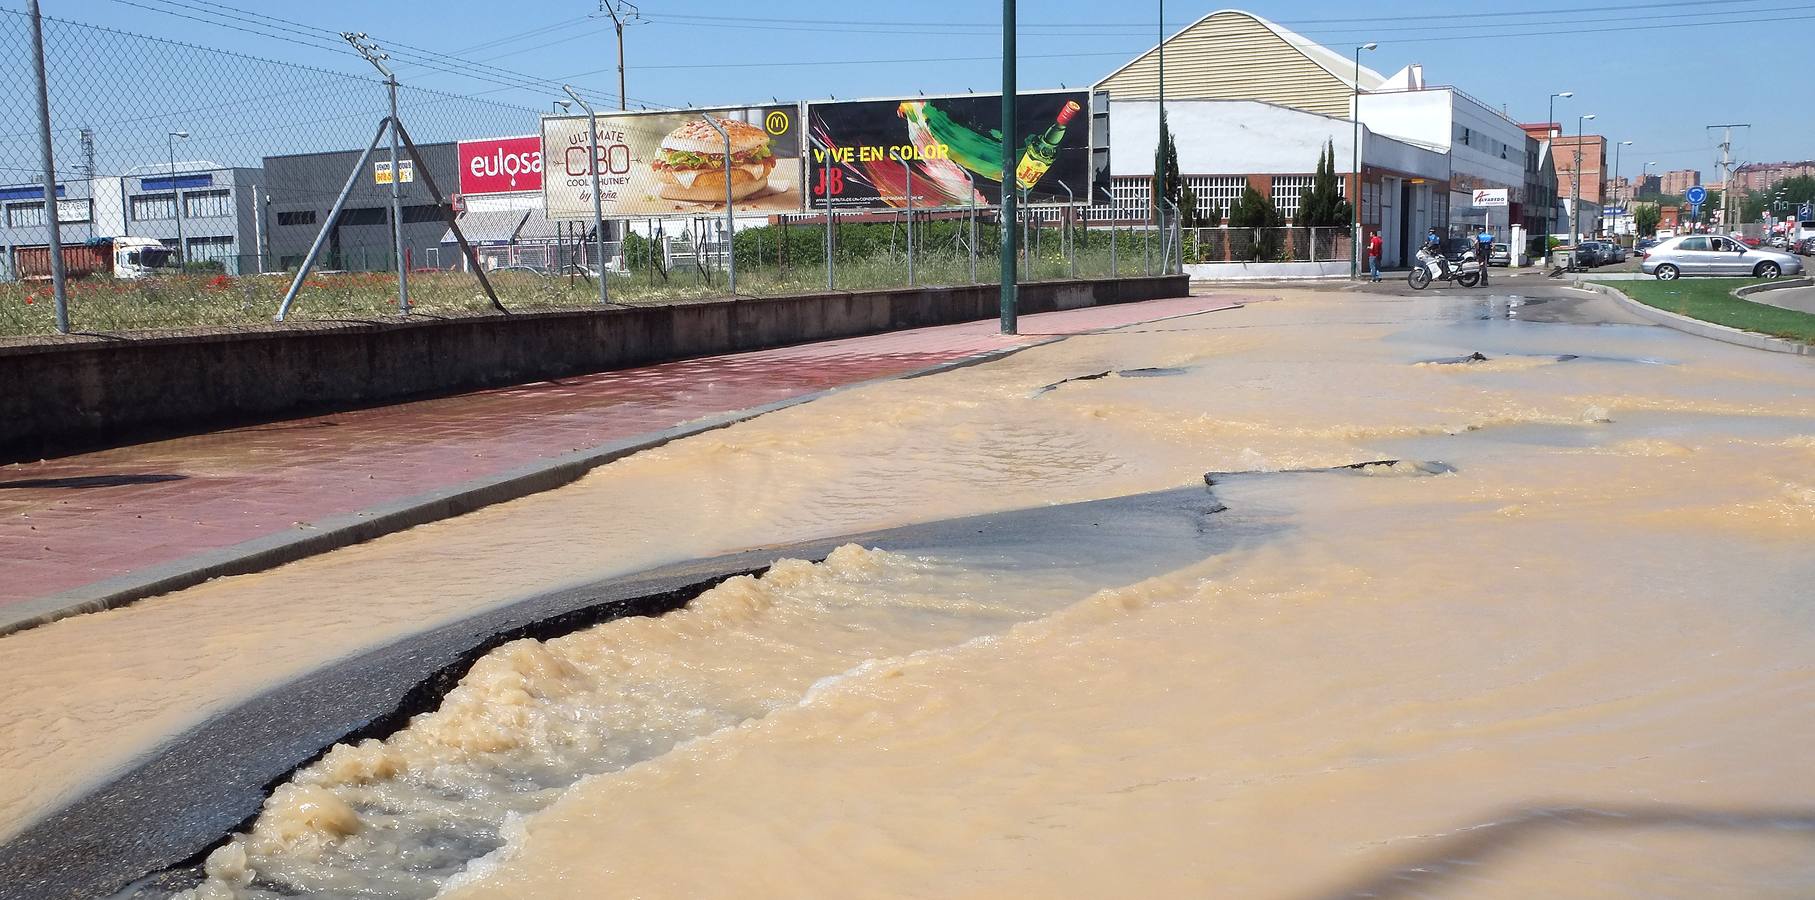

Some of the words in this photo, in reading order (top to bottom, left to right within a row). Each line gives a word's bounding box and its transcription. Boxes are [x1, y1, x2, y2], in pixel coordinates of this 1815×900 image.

[569, 130, 625, 145] ULTMATE
[565, 144, 630, 177] CBO
[860, 145, 884, 162] EN
[889, 144, 949, 161] COLOR
[470, 147, 542, 178] eulosa
[566, 178, 590, 187] COOL
[598, 176, 631, 186] HUTNEY
[580, 190, 592, 203] by
